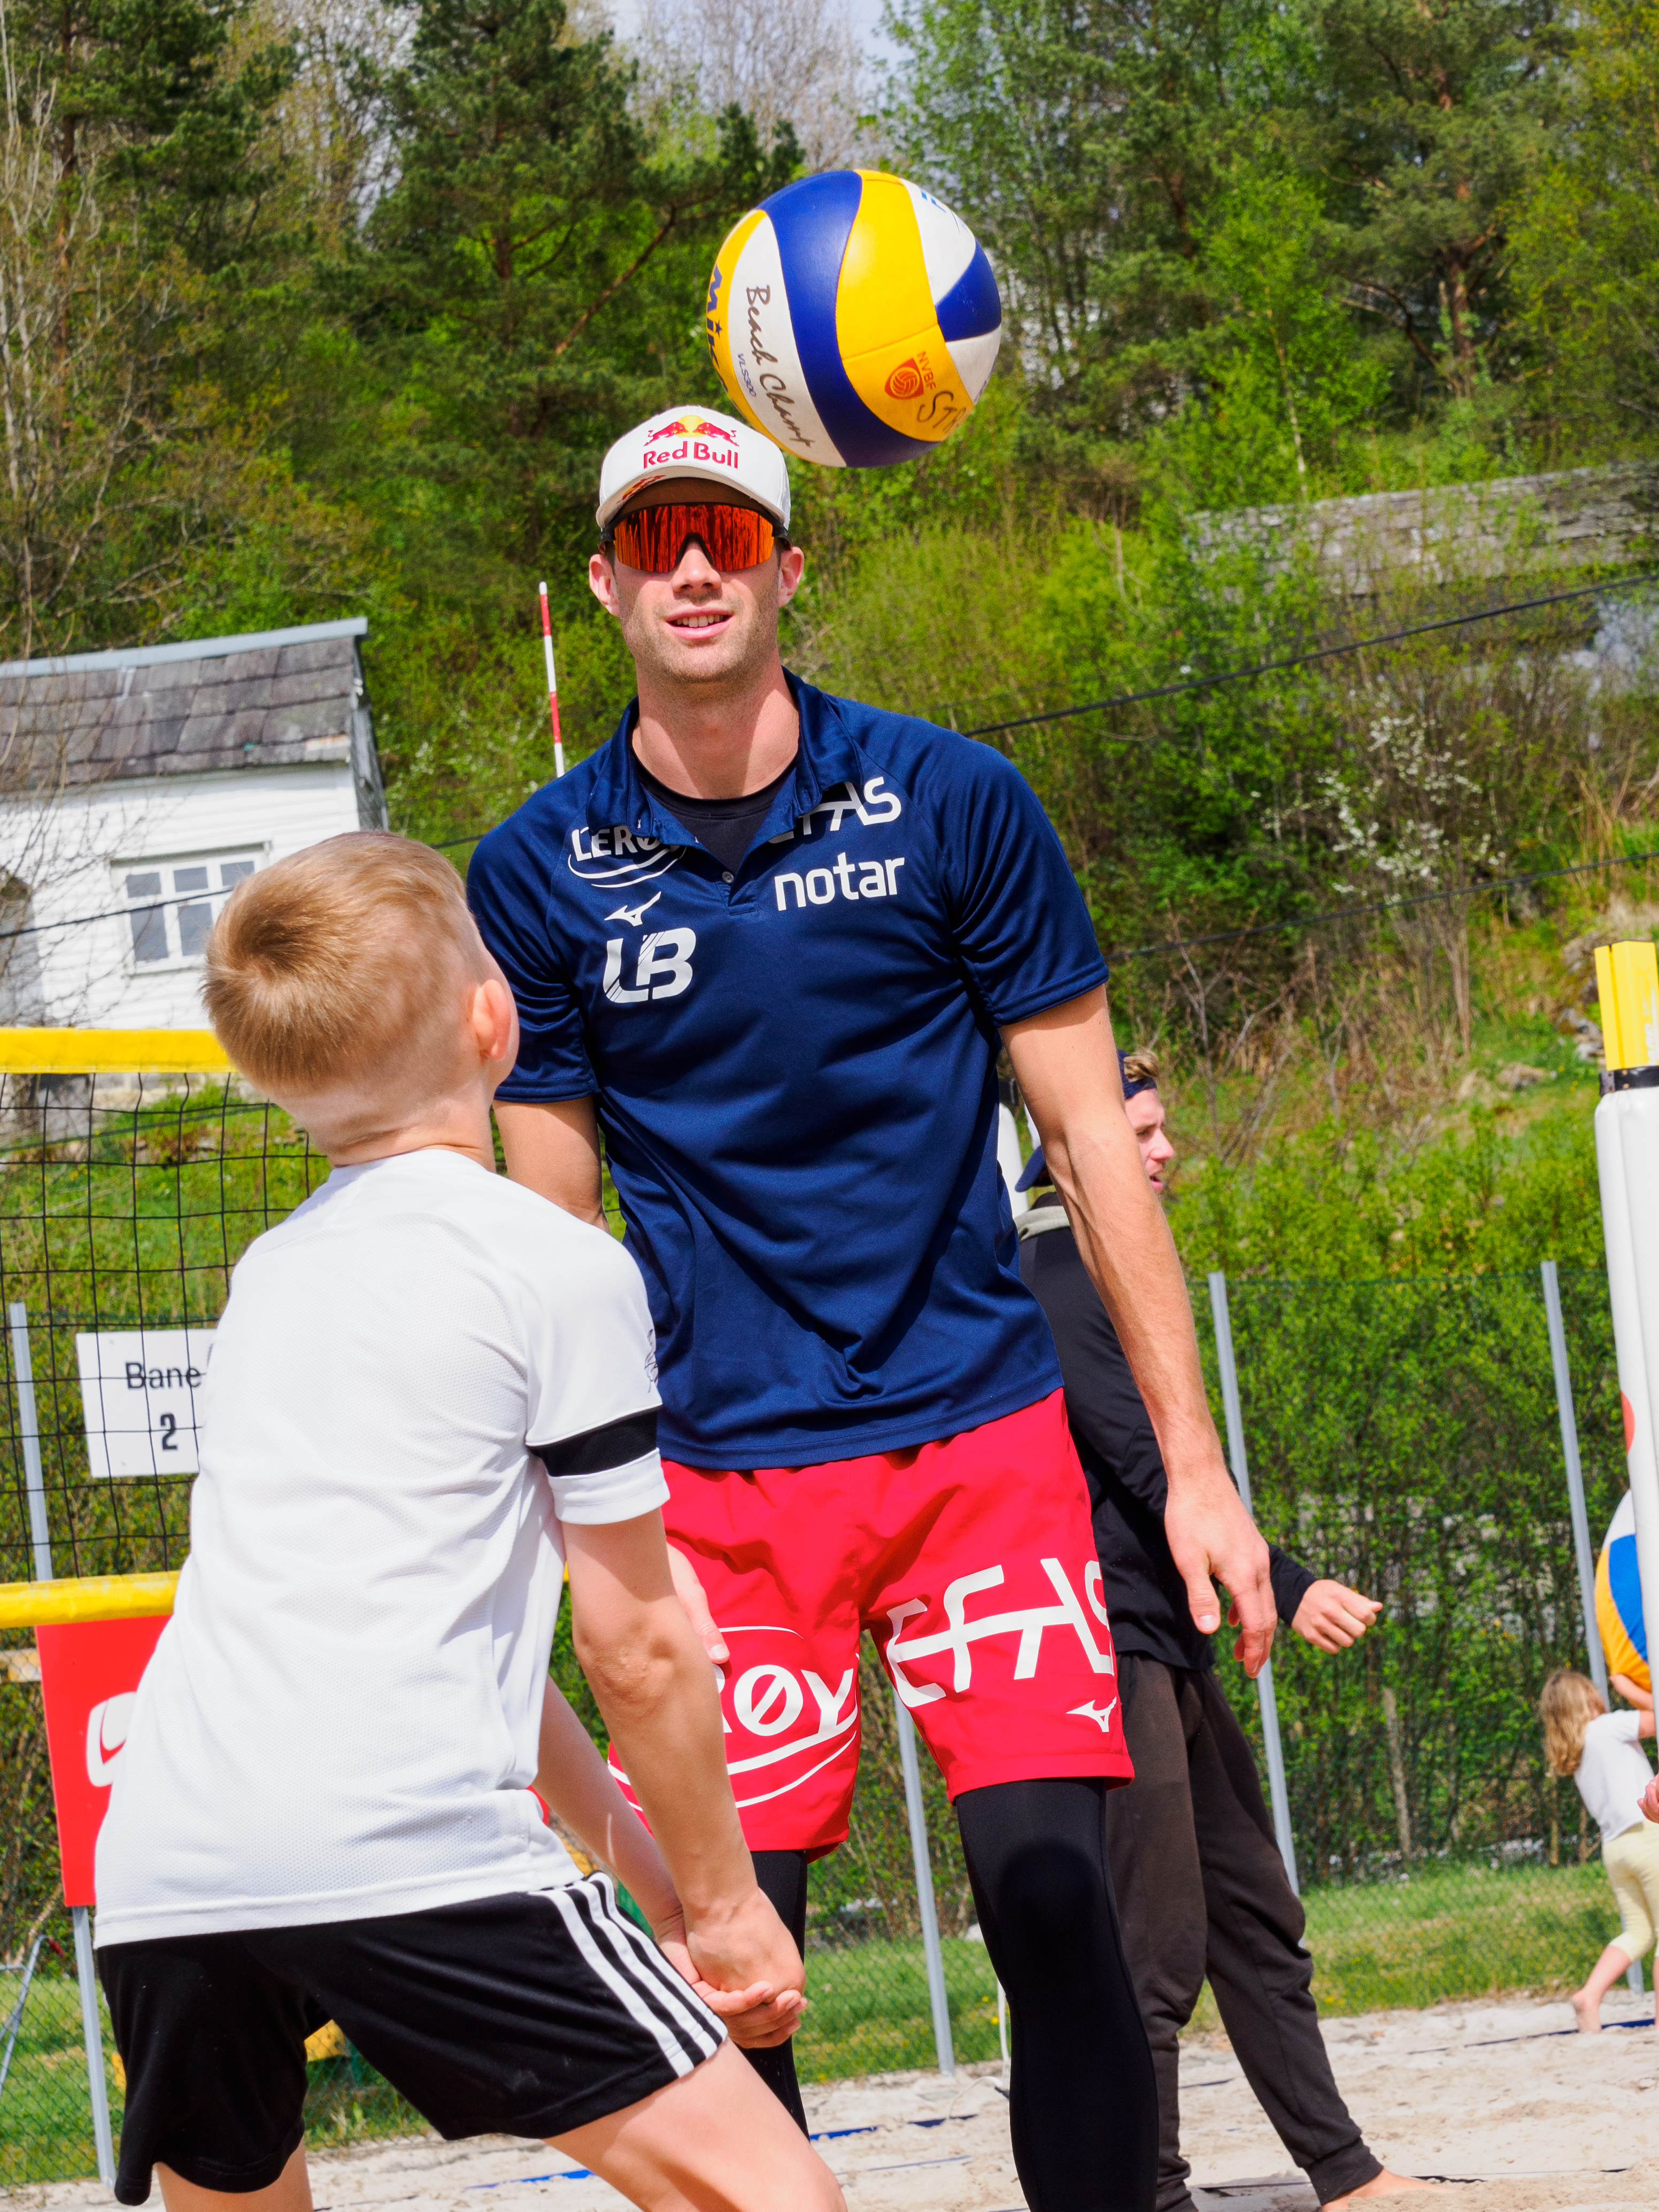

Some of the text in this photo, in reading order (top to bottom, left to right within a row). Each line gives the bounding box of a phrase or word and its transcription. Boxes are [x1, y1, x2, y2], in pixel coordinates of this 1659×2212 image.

[746, 285, 777, 365] Beach
[737, 353, 757, 397] VLS300
[917, 351, 936, 390] NVBF
[643, 441, 738, 469] Red Bull
[774, 852, 905, 911] notar
[125, 1362, 202, 1390] Bane
[160, 1413, 178, 1450] 2
[713, 1664, 854, 1736] ØY
